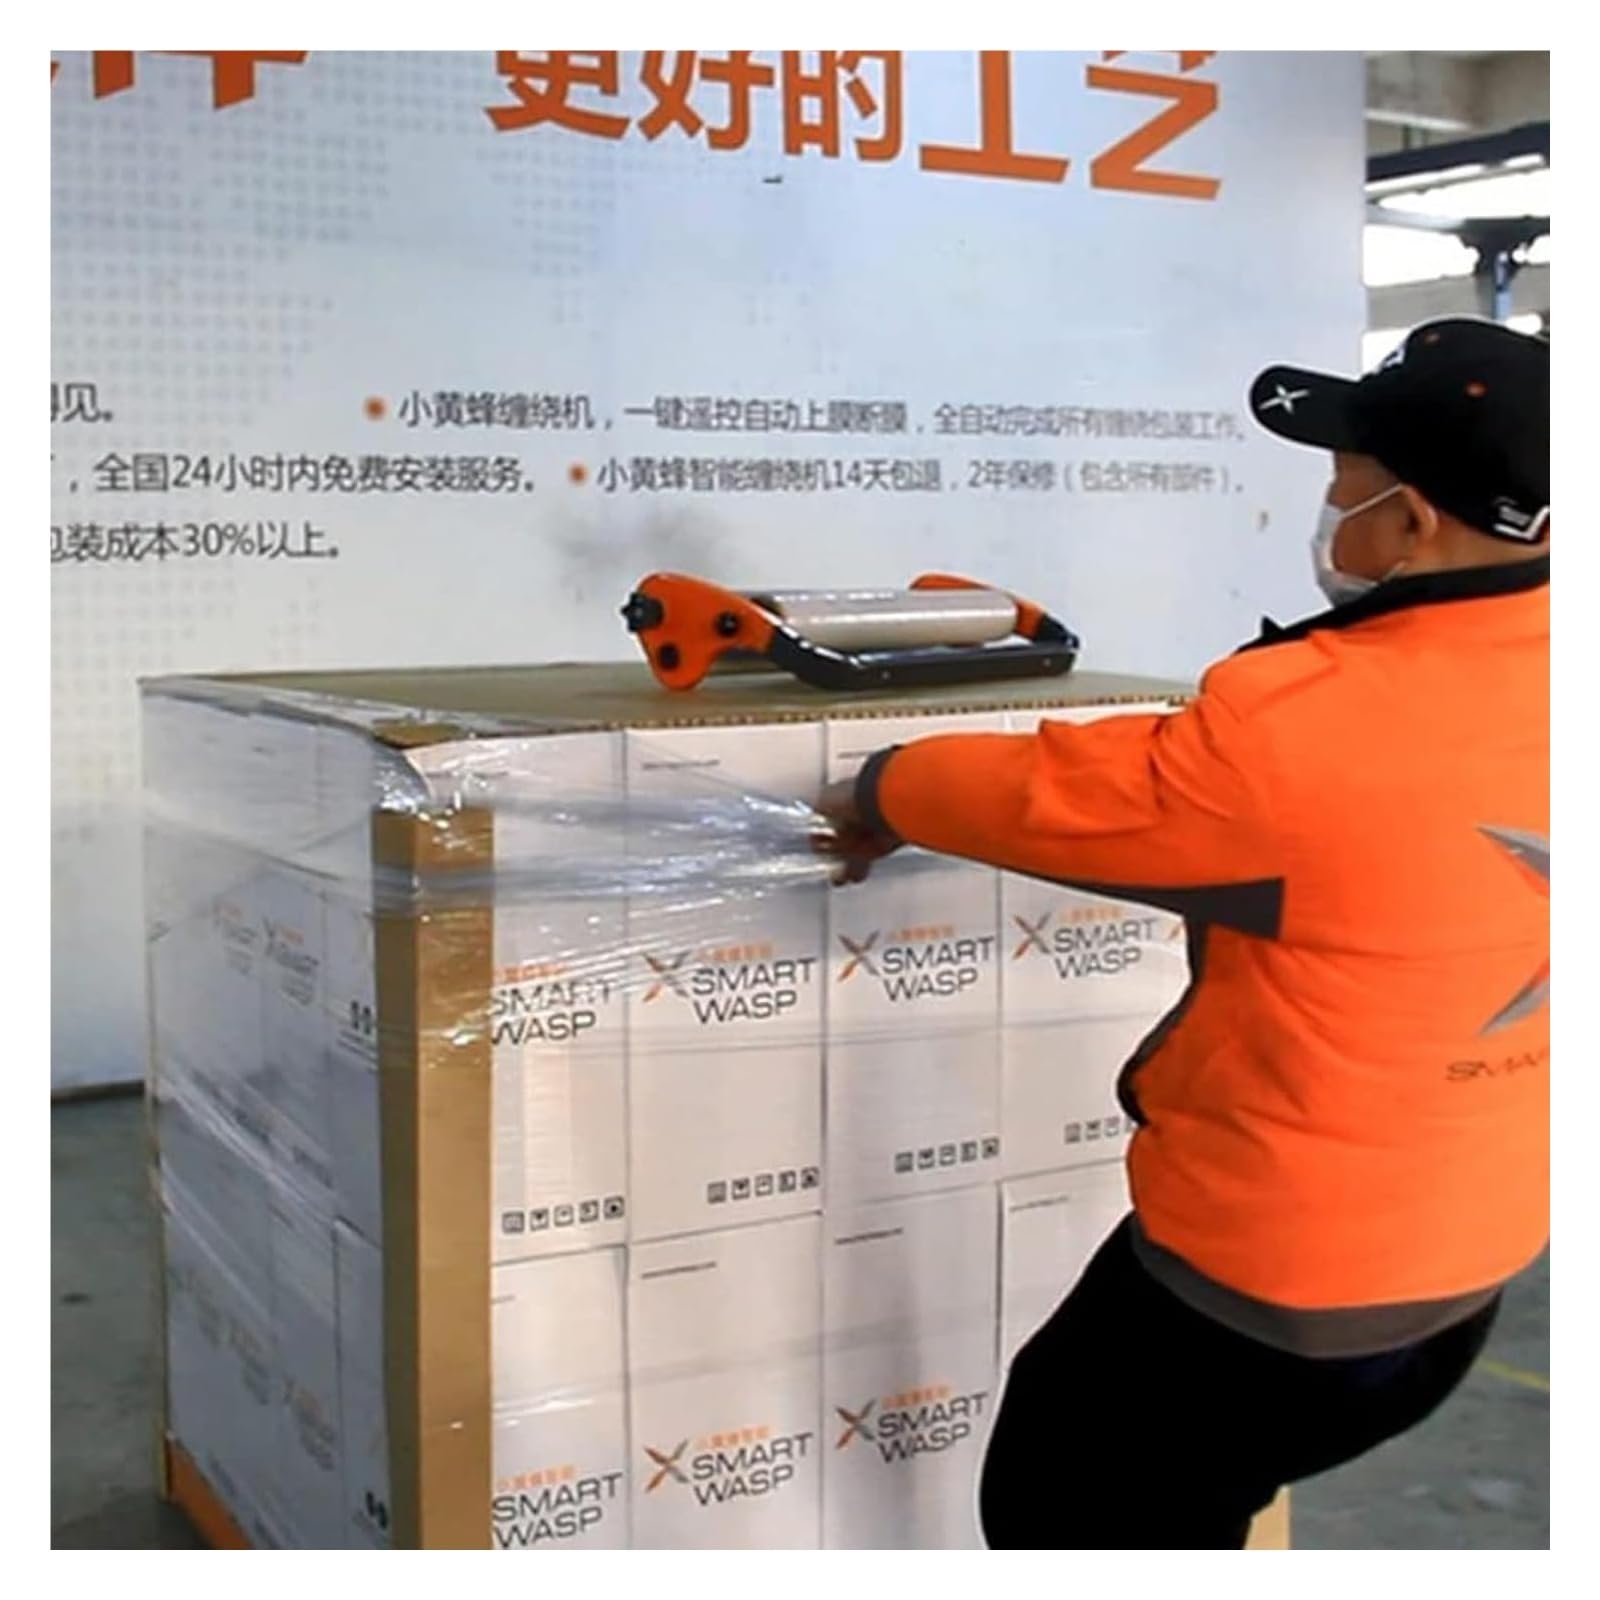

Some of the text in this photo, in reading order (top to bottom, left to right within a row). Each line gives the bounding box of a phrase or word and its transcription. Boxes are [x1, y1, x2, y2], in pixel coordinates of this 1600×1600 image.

[50, 382, 113, 422] 见。
[882, 935, 995, 975] SMART
[1054, 918, 1157, 953] SMART
[692, 957, 817, 996] SMART
[1055, 947, 1142, 980] WASP
[884, 967, 978, 1002] WASP
[694, 989, 798, 1024] WASP
[491, 1010, 596, 1046] WASP
[878, 1391, 989, 1439] SMART
[692, 1432, 814, 1481] SMART
[878, 1421, 971, 1464] WASP
[492, 1472, 623, 1523] SMART
[694, 1464, 794, 1506] WASP
[493, 1506, 603, 1549] WASP
